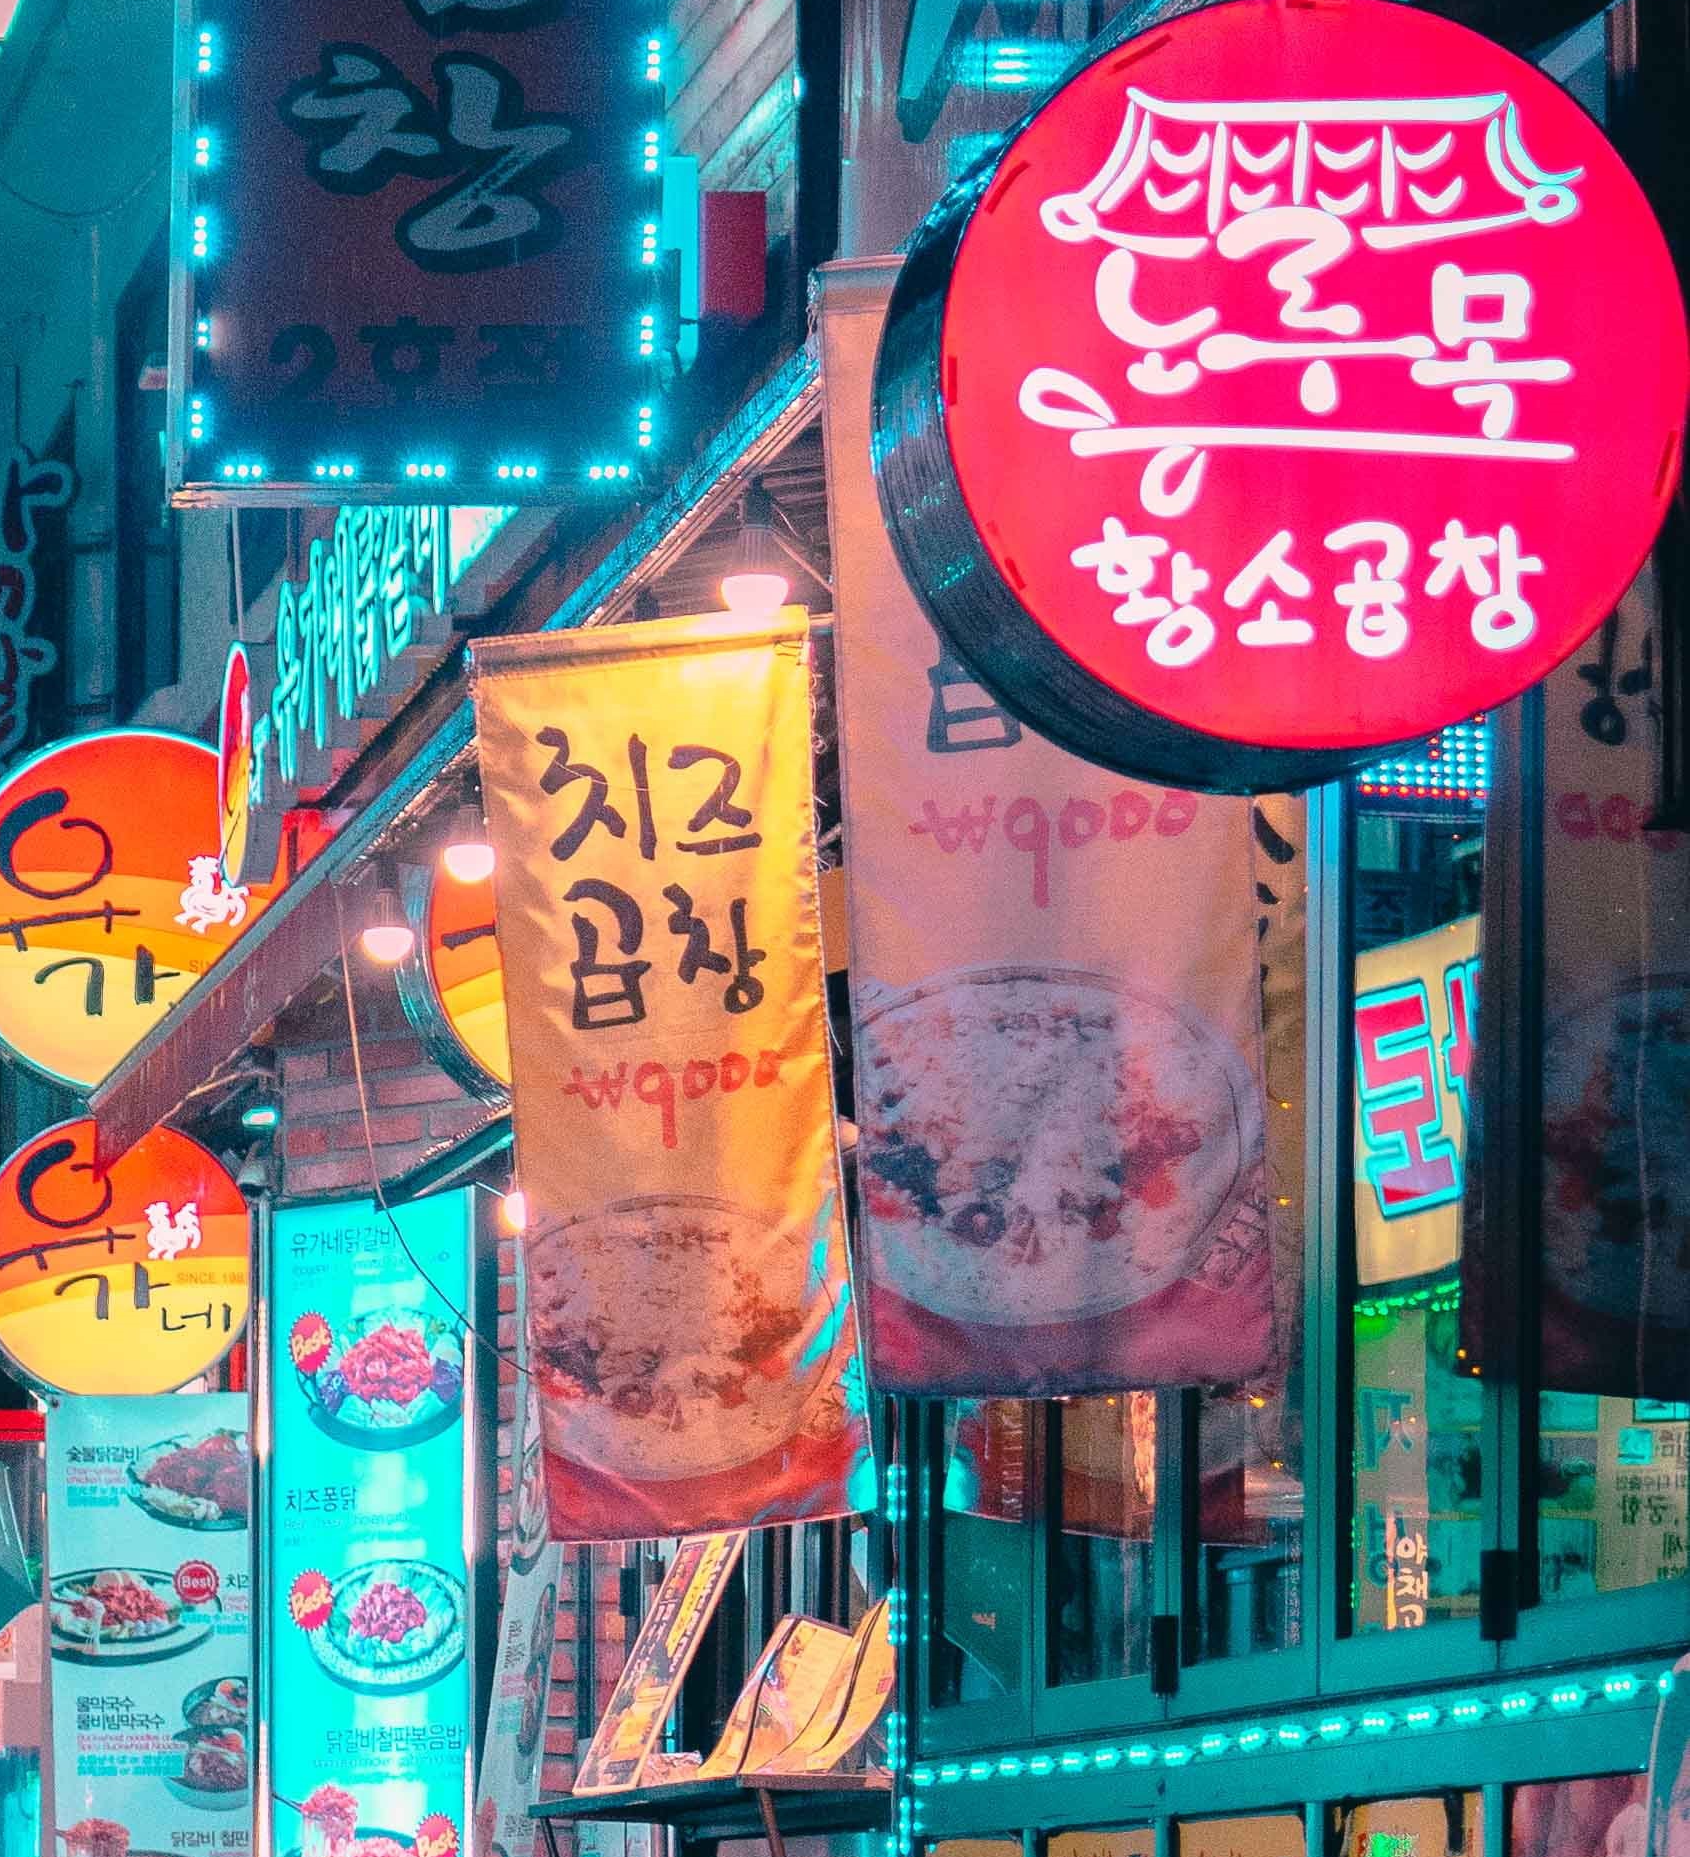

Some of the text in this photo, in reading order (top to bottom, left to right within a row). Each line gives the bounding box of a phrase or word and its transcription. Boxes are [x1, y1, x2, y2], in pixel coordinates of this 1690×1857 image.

[1070, 516, 1544, 669] 황소곱창
[536, 726, 763, 865] 치즈
[564, 878, 766, 1030] 곱창
[291, 1227, 397, 1258] 유가네닭갈비
[284, 1485, 357, 1515] 치즈퐁닭
[181, 1578, 214, 1591] Best
[325, 1723, 465, 1756] 닭갈비철판볶음밥
